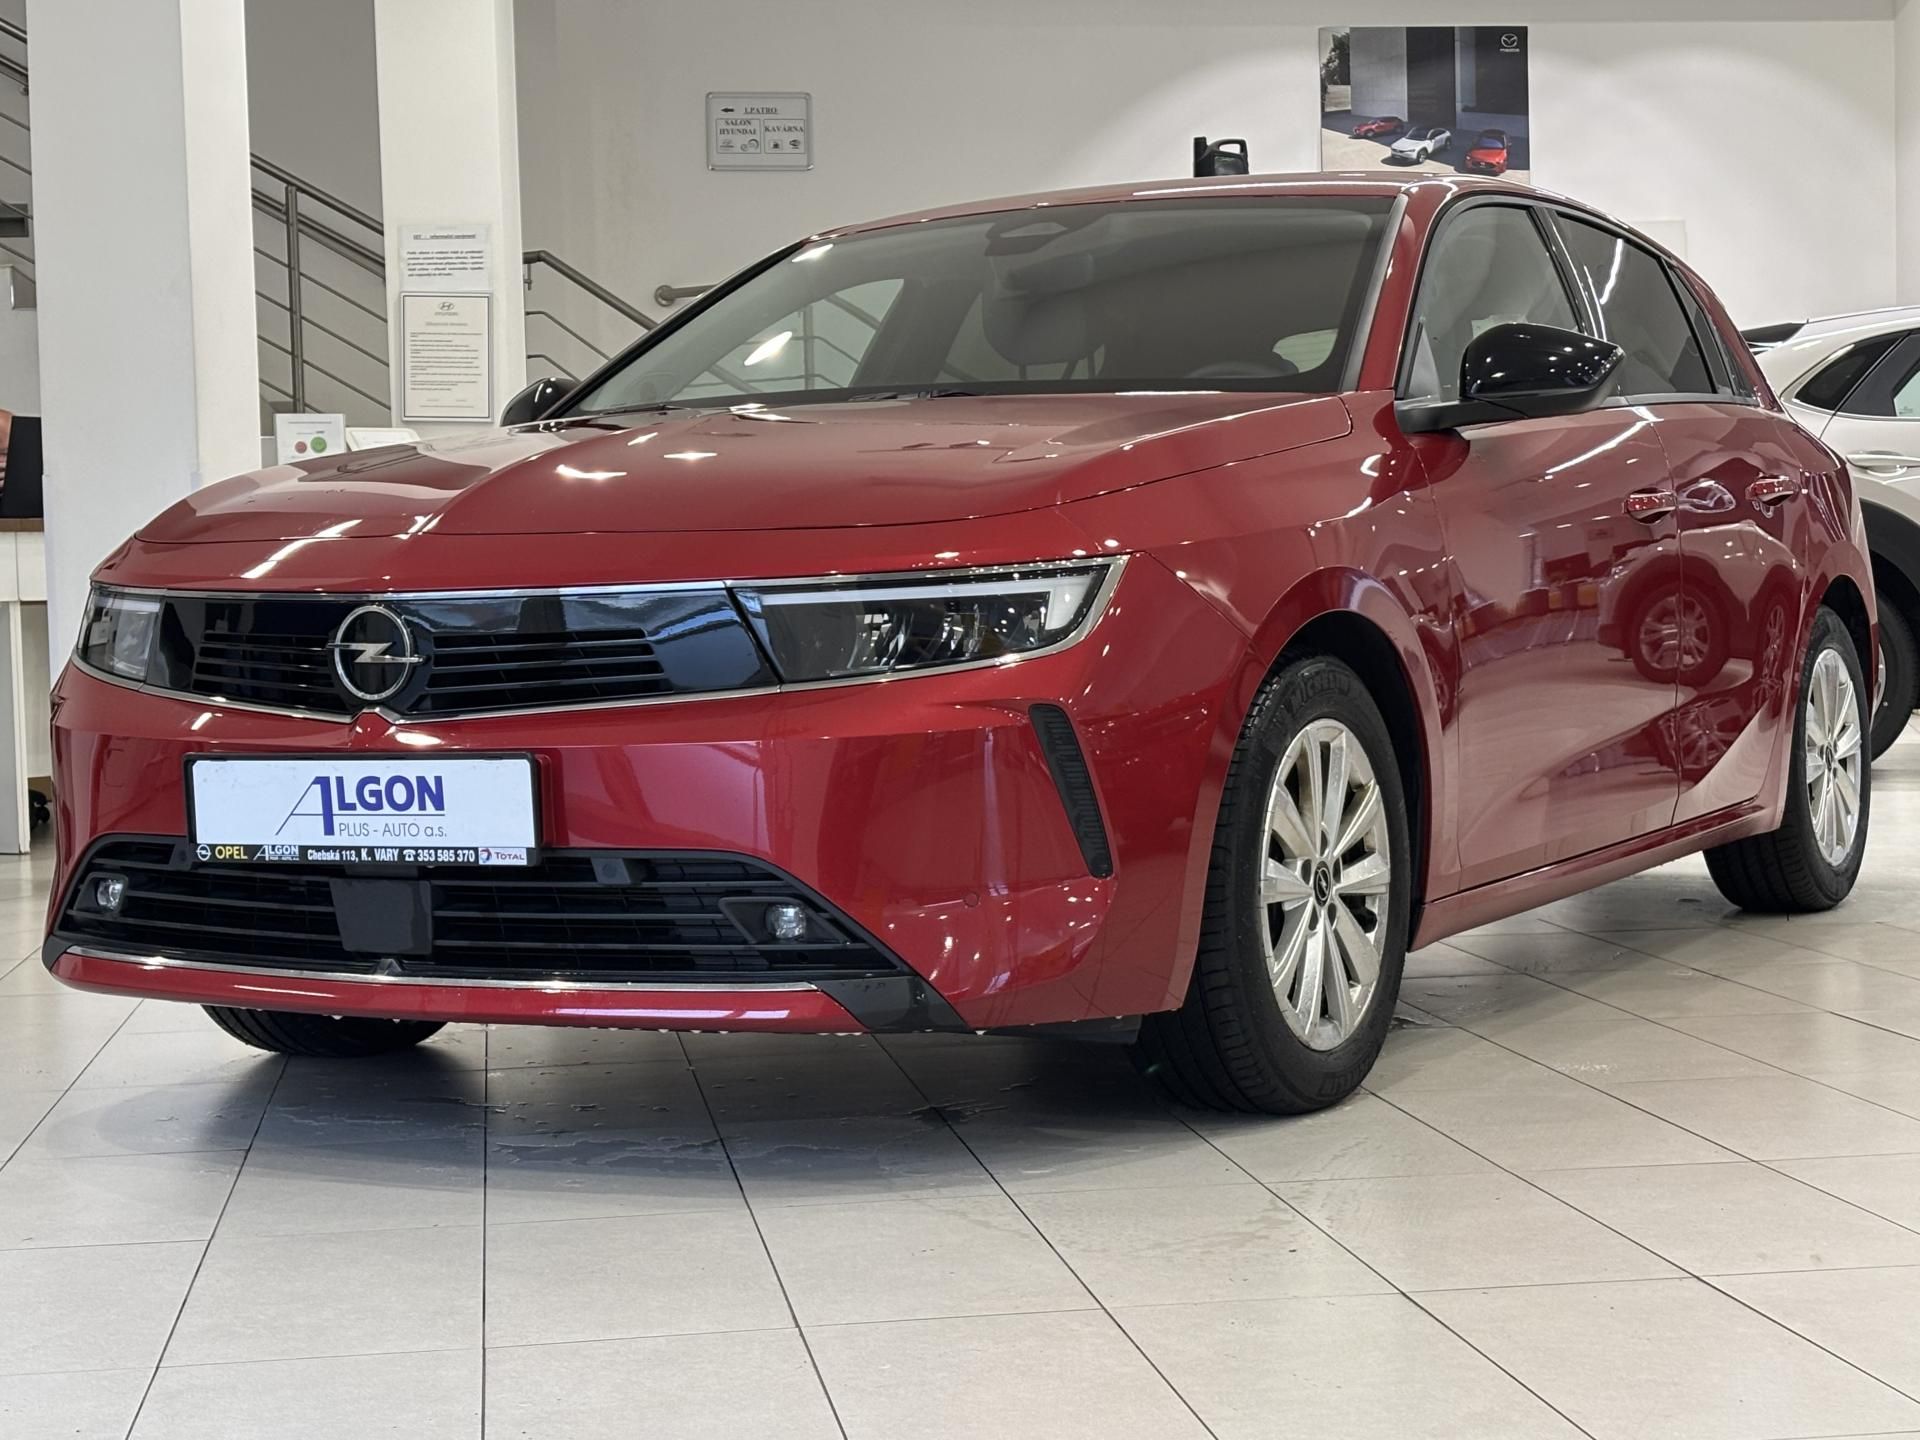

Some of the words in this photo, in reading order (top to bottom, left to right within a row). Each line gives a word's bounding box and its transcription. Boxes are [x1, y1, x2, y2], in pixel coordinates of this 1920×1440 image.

[274, 775, 446, 836] ALGON
[339, 823, 370, 837] PLUS
[382, 823, 419, 837] AUTO
[424, 825, 447, 837] a.s.
[214, 845, 248, 860] OPEL
[253, 844, 300, 861] ALGON
[307, 849, 340, 861] Chebská
[341, 850, 358, 863] 113,
[361, 848, 371, 861] K.
[374, 848, 399, 861] VARY
[417, 849, 435, 862] 353
[437, 849, 455, 862] 585
[457, 850, 475, 863] 370
[494, 851, 525, 860] TOTAL
